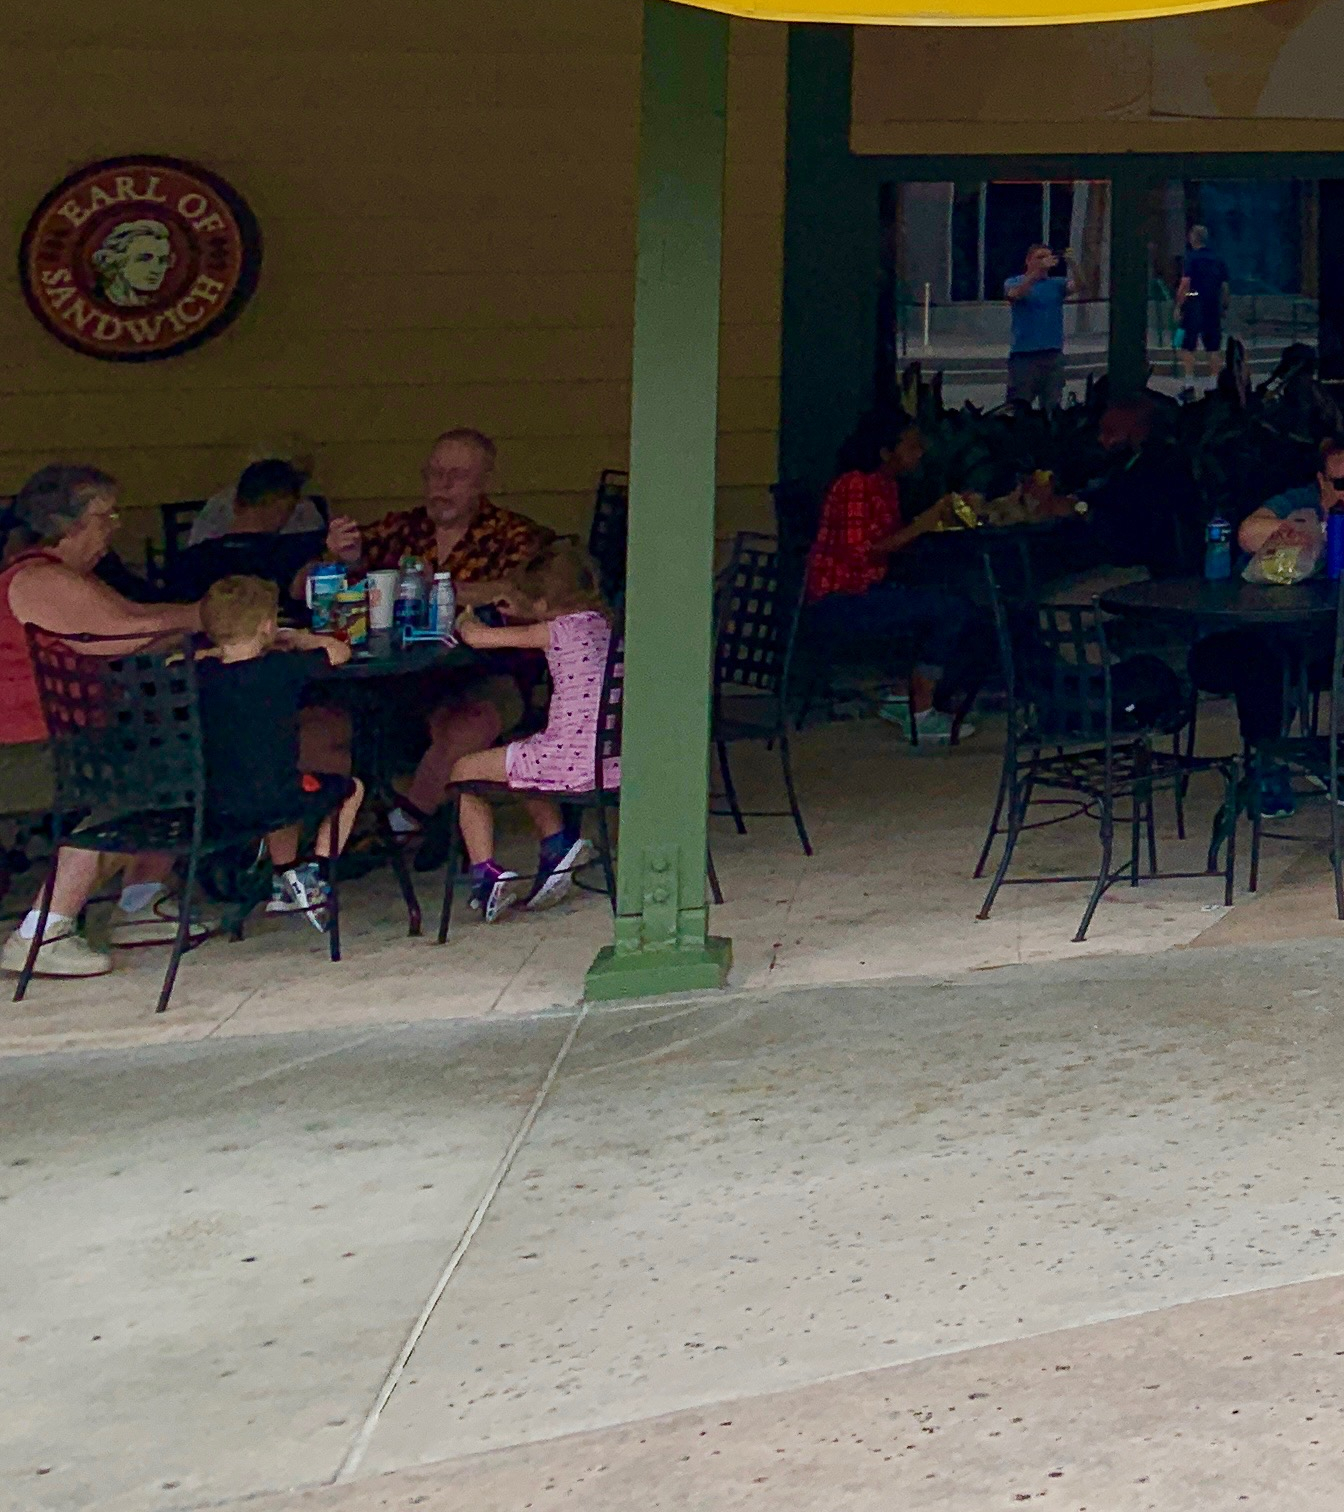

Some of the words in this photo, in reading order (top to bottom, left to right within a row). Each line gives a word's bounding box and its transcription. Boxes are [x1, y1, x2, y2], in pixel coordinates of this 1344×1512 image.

[57, 175, 167, 228] EARL
[177, 193, 226, 233] OF
[40, 267, 225, 343] SANDWICH
